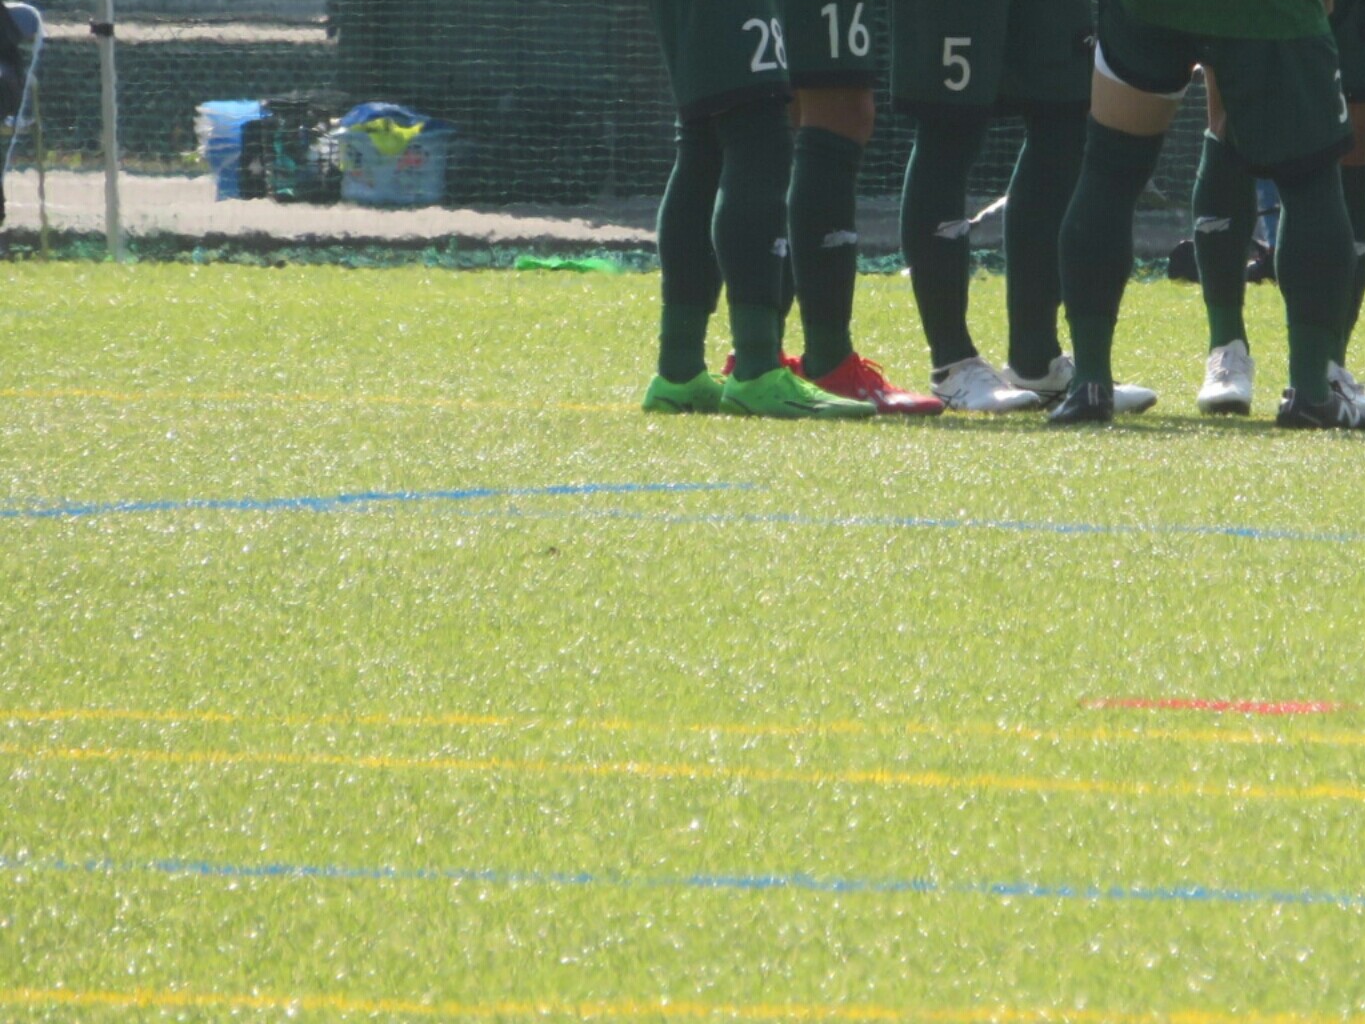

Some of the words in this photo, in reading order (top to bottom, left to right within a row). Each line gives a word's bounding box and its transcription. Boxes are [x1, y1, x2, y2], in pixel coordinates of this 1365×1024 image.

[741, 17, 788, 73] 28
[821, 2, 870, 59] 16
[942, 37, 972, 91] 5
